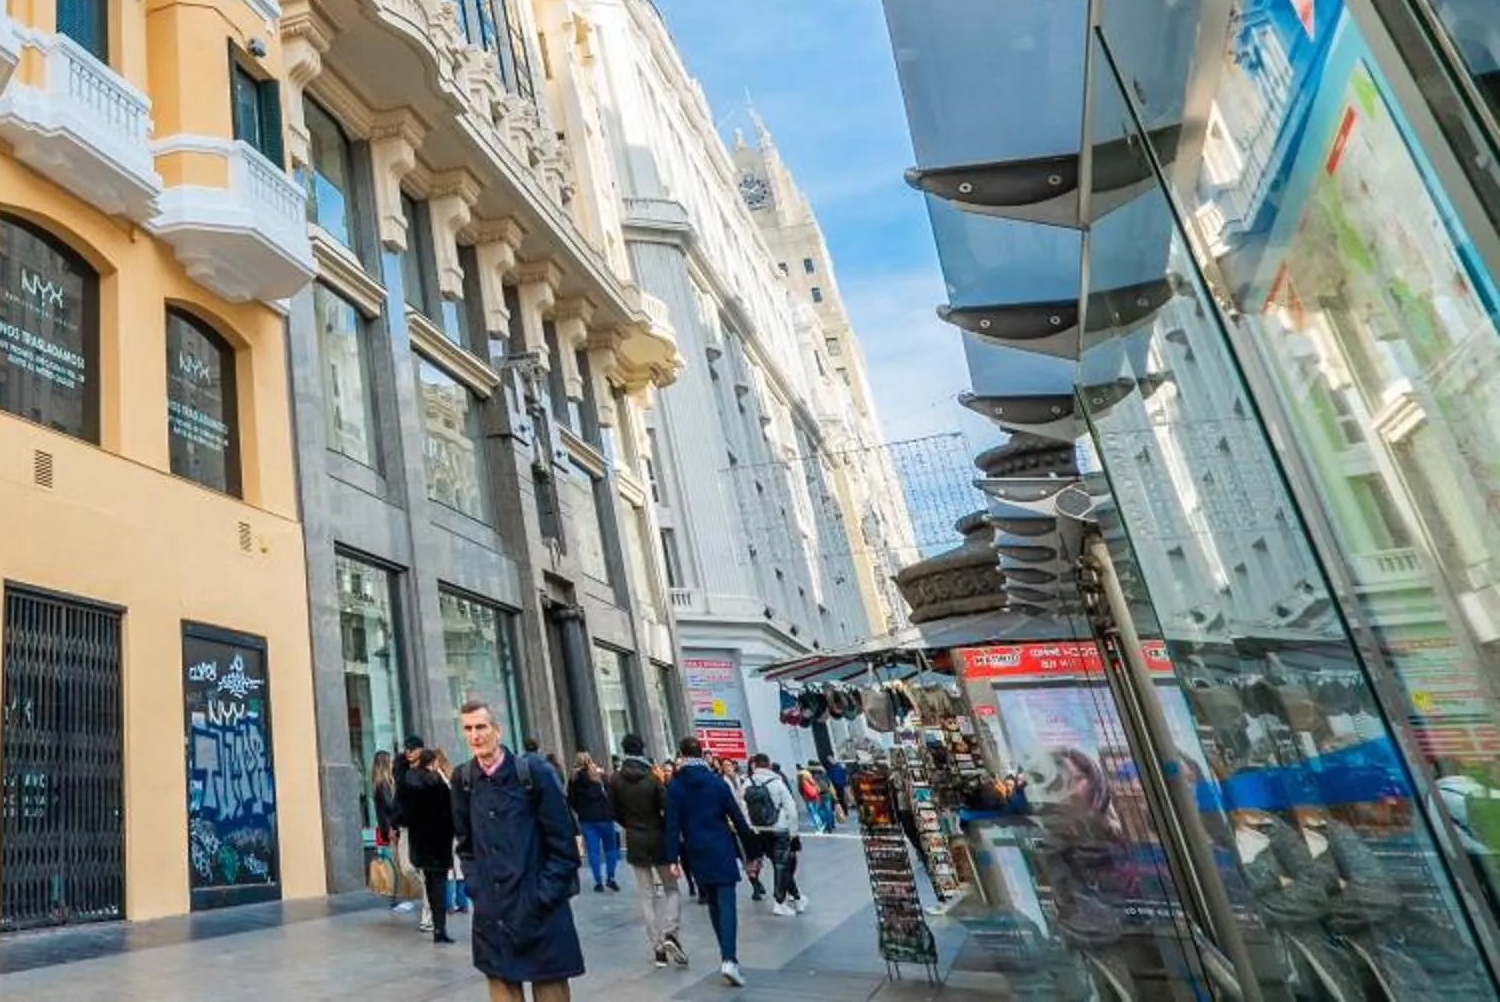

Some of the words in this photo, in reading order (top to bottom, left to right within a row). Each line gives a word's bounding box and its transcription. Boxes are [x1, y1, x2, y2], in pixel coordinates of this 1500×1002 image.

[21, 268, 63, 309] NYX
[180, 349, 211, 386] NYX
[208, 699, 245, 727] NYX
